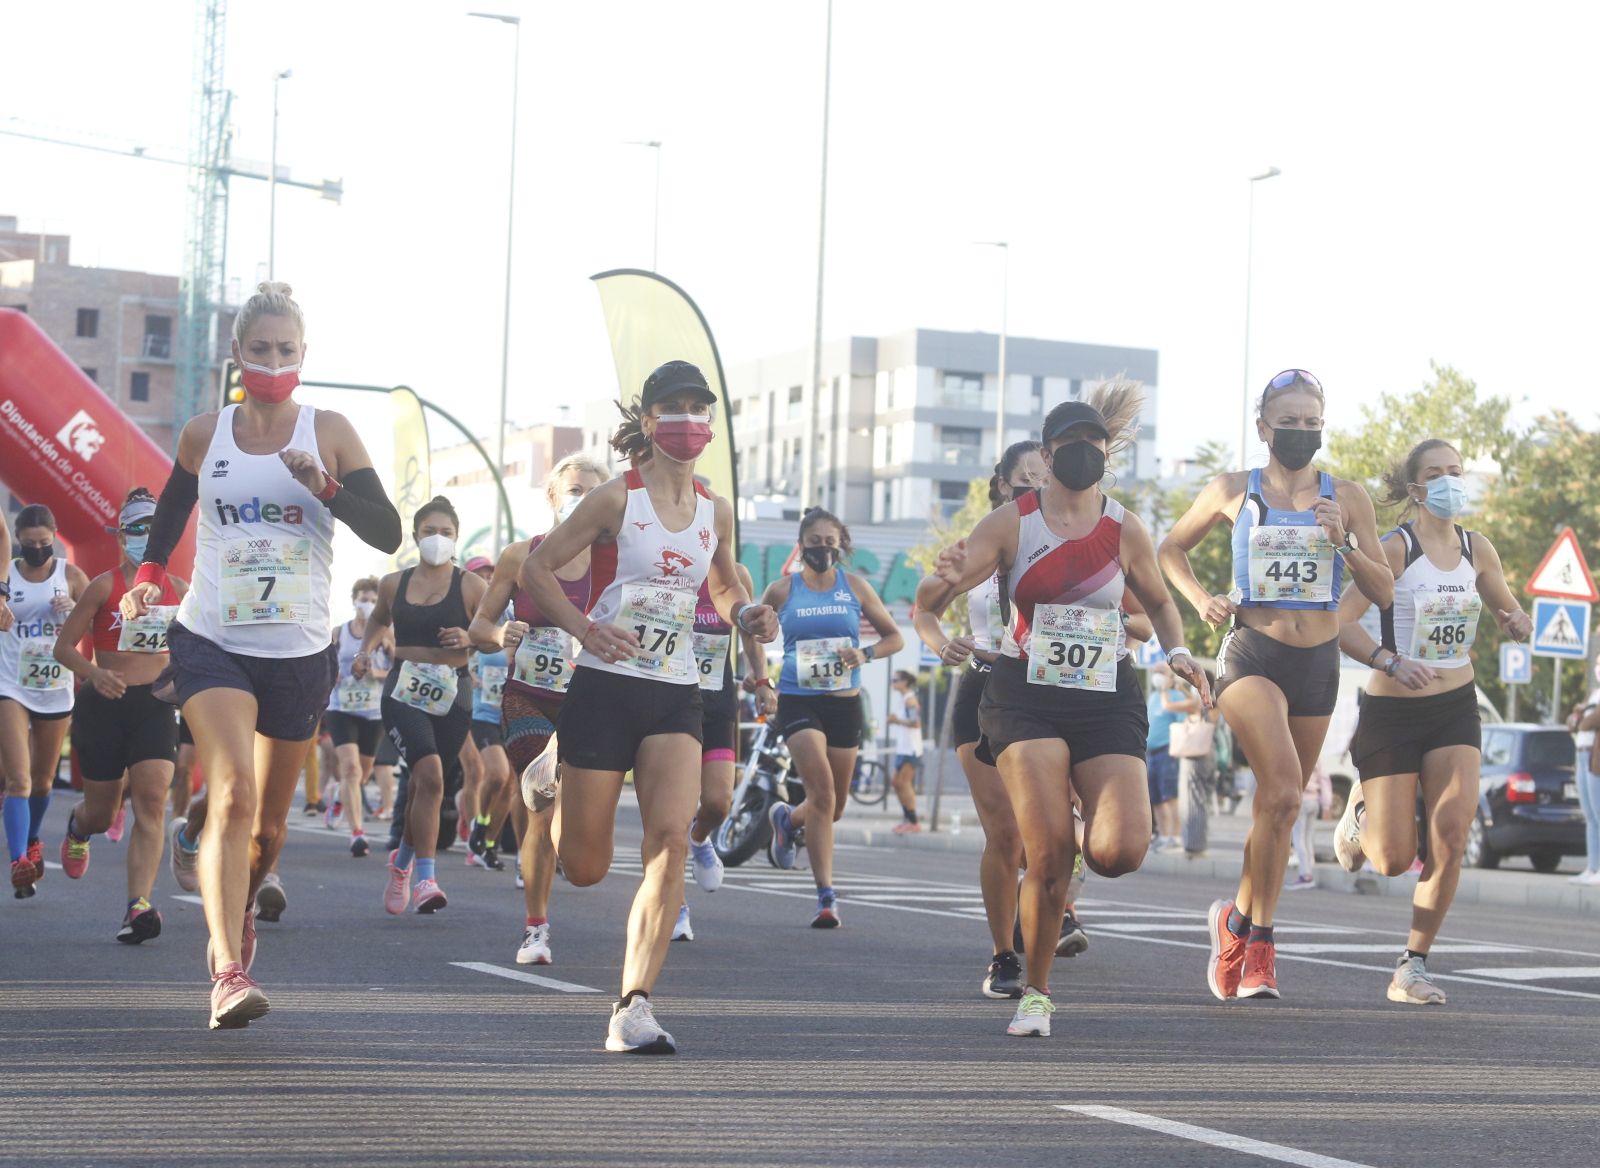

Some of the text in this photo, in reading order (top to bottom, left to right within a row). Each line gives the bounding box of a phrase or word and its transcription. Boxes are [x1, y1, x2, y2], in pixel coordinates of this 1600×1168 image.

[0, 399, 117, 518] Diputación de Córdoba
[215, 497, 304, 525] indea
[1028, 545, 1050, 563] Joma
[1265, 561, 1318, 583] 443
[258, 576, 276, 601] 7
[1437, 584, 1465, 593] Joma
[796, 605, 849, 617] TROTASIERRA
[635, 624, 679, 656] 176
[1428, 624, 1466, 646] 486
[535, 654, 564, 676] 95
[1048, 642, 1103, 669] 307
[1507, 649, 1525, 677] P
[29, 664, 61, 679] 240
[811, 661, 844, 678] 118
[347, 691, 371, 702] 152
[407, 677, 443, 702] 360
